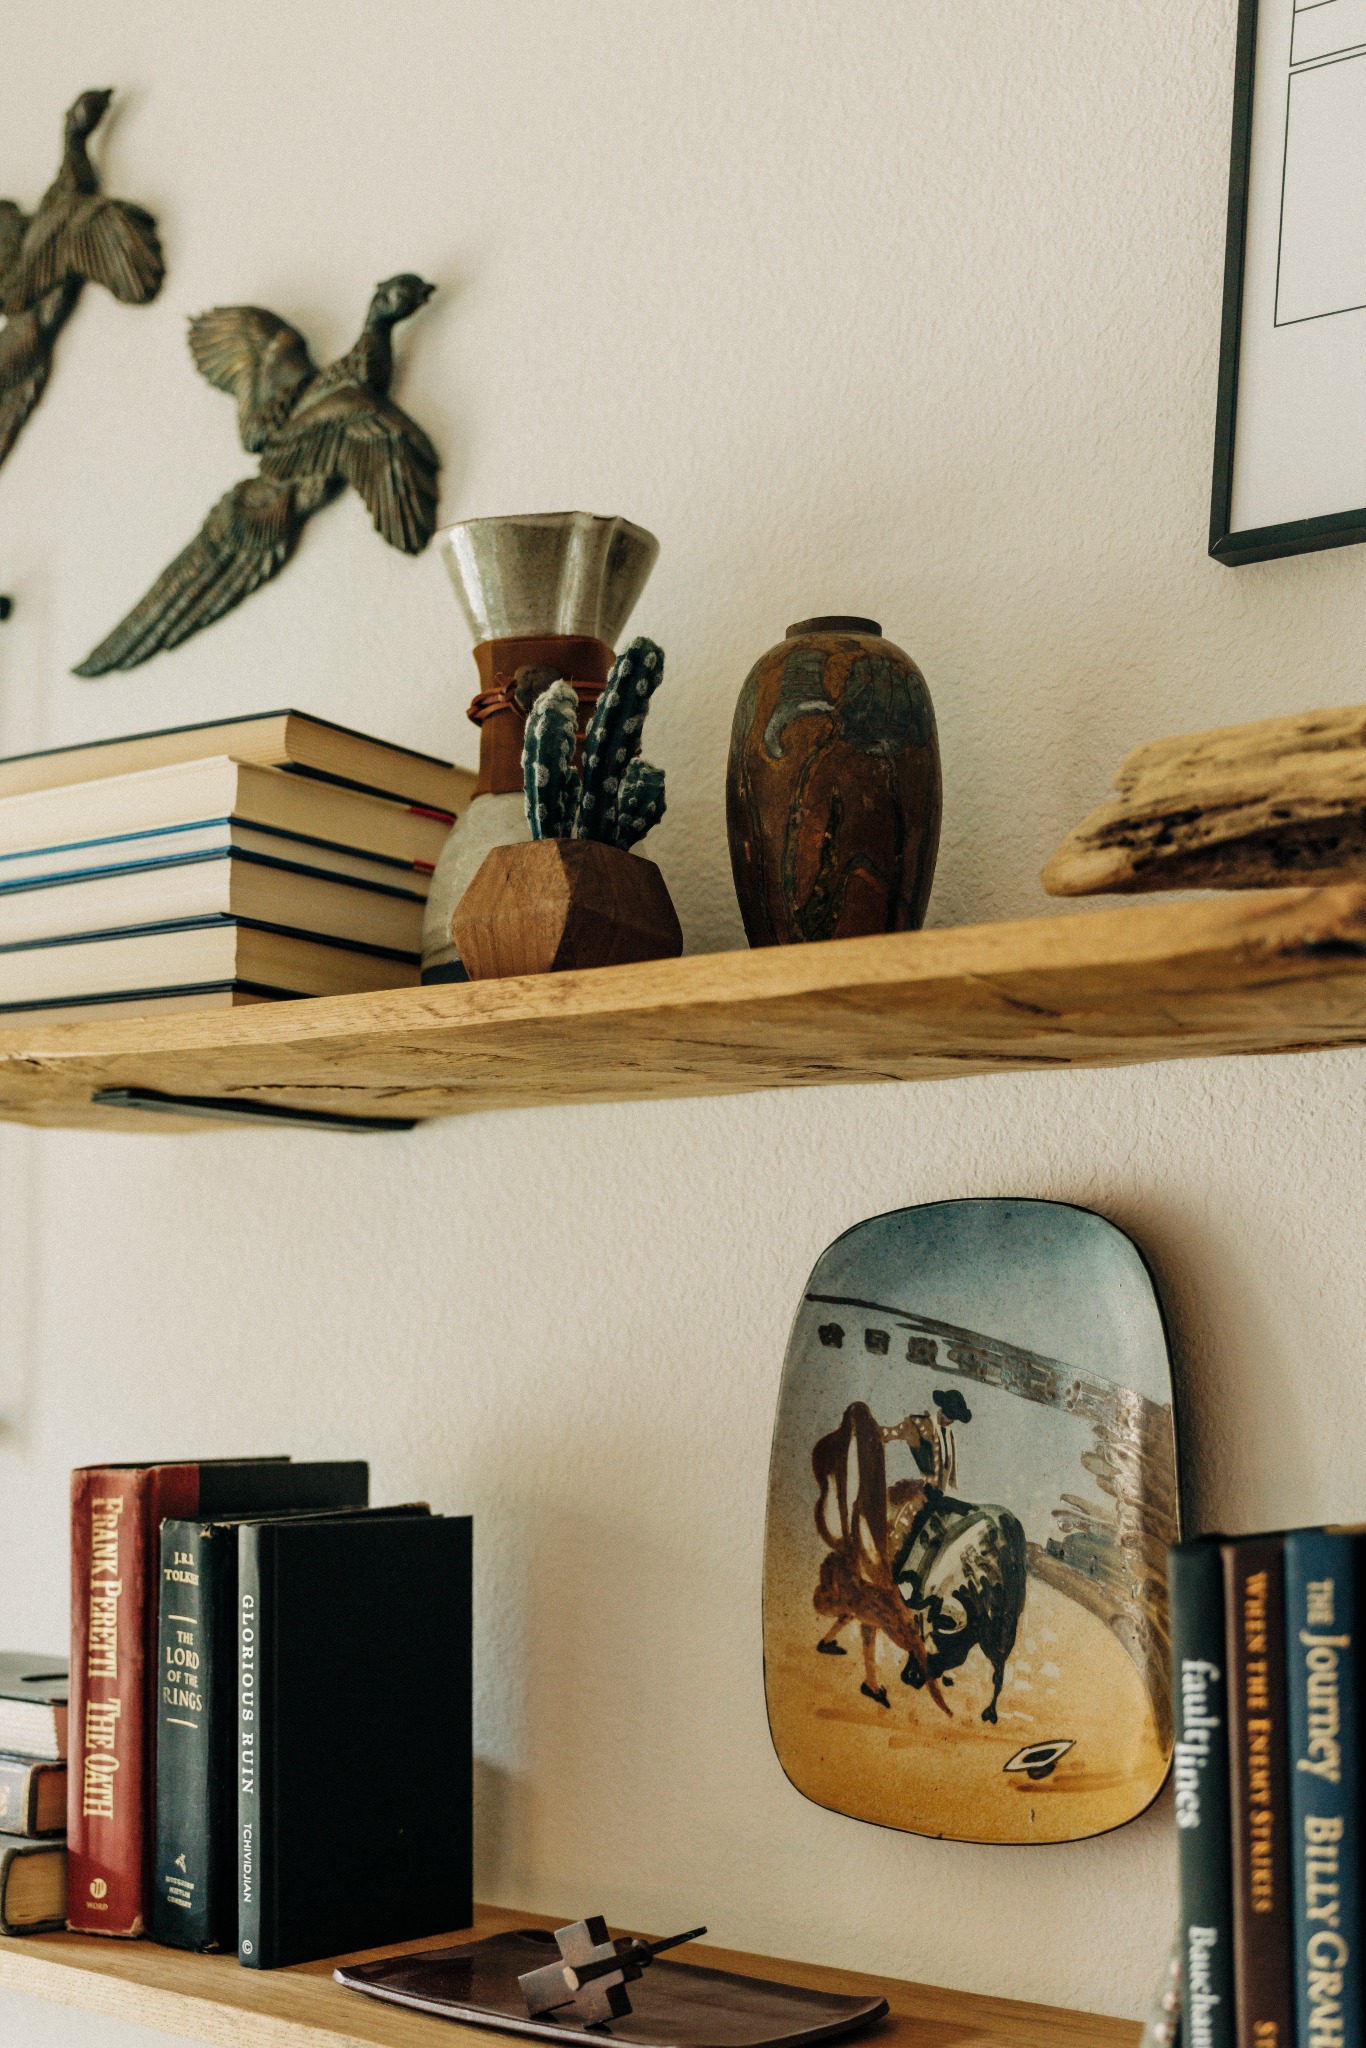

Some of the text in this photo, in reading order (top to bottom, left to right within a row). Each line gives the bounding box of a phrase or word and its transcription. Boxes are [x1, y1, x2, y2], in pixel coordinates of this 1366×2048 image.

[88, 1496, 124, 1680] FRANK PERETTI
[166, 1646, 200, 1670] LORD
[167, 1669, 199, 1688] OF THE
[176, 1630, 194, 1646] THE
[1296, 1576, 1351, 1784] THE Journey
[163, 1686, 203, 1711] RINGS
[241, 1594, 255, 1795] GLORIOUS RUIN
[83, 1698, 121, 1820] THE OATH
[243, 1823, 252, 1903] TCHIVIDJIAN
[1304, 1815, 1345, 1929] BILLY
